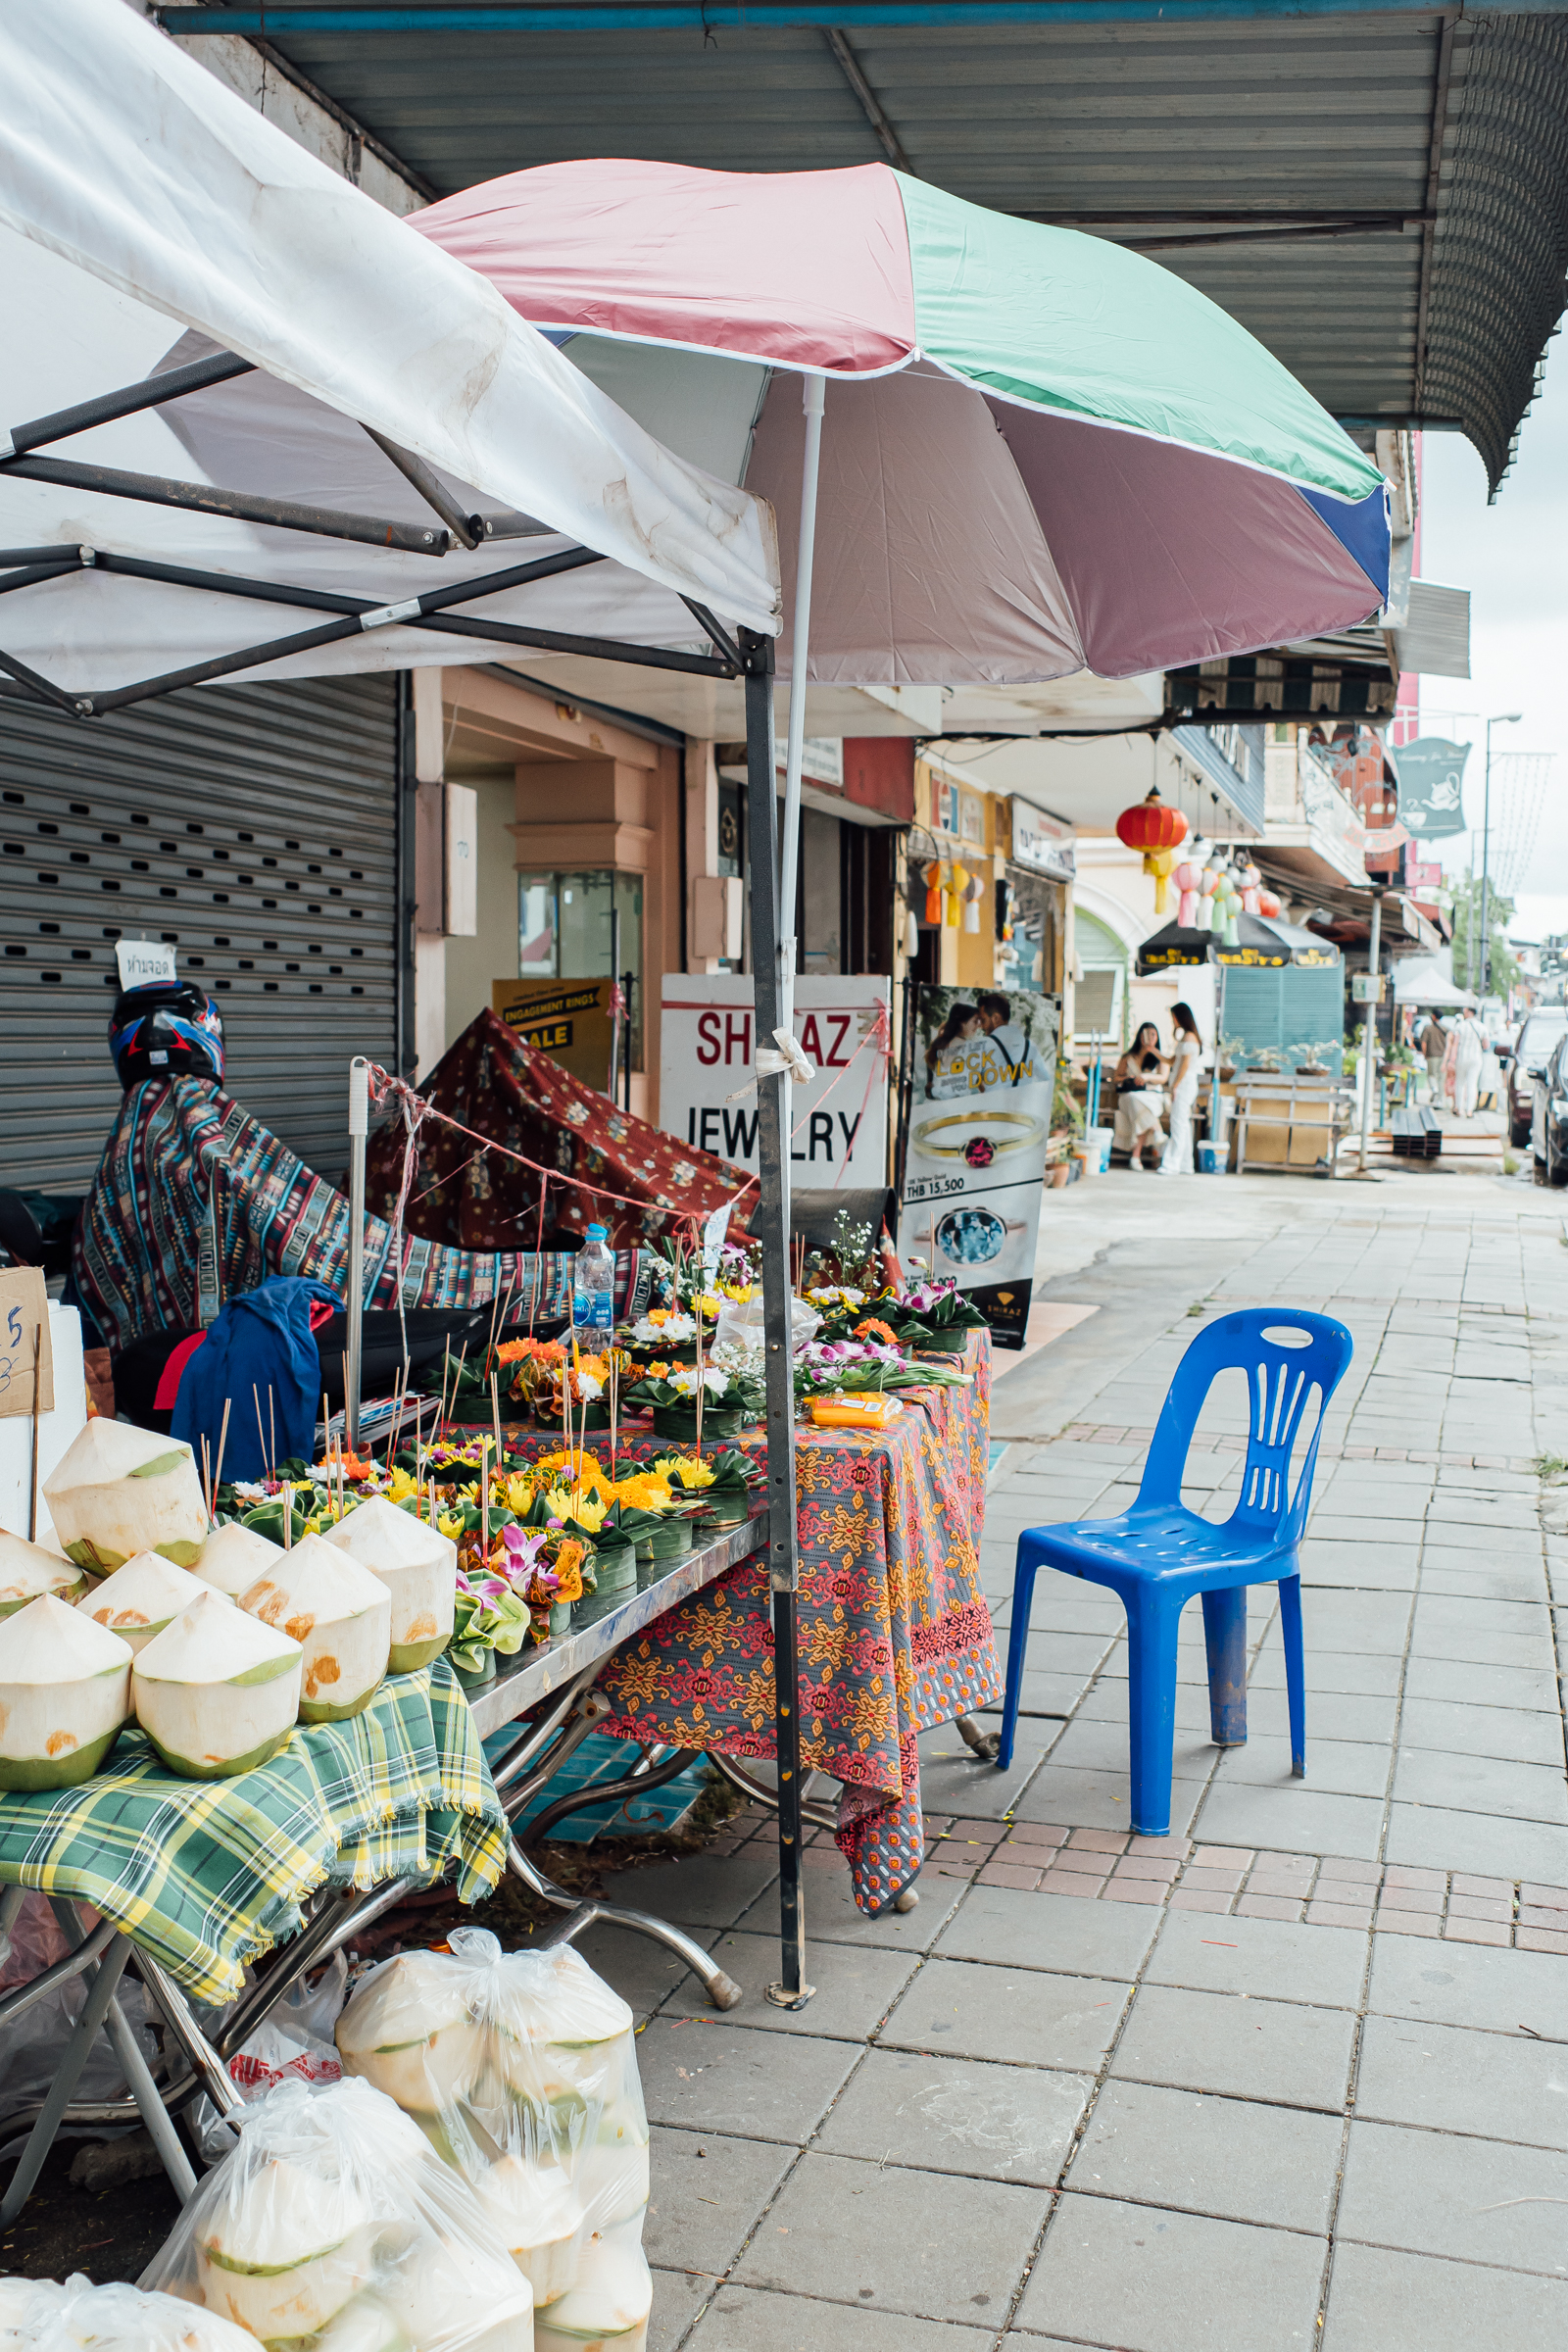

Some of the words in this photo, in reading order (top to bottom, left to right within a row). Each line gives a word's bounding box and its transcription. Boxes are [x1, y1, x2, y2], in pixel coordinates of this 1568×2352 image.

[505, 1000, 564, 1023] ENGAGEMENT
[565, 993, 594, 1009] RINGS
[526, 1025, 567, 1049] ALE
[697, 1011, 851, 1067] SHAZ
[968, 1060, 1033, 1089] DOWN
[688, 1106, 861, 1162] JEWLRY
[906, 1185, 925, 1198] THB
[929, 1177, 964, 1195] 15,500
[987, 1304, 1022, 1317] SHIRAZ
[0, 1305, 24, 1348] 5
